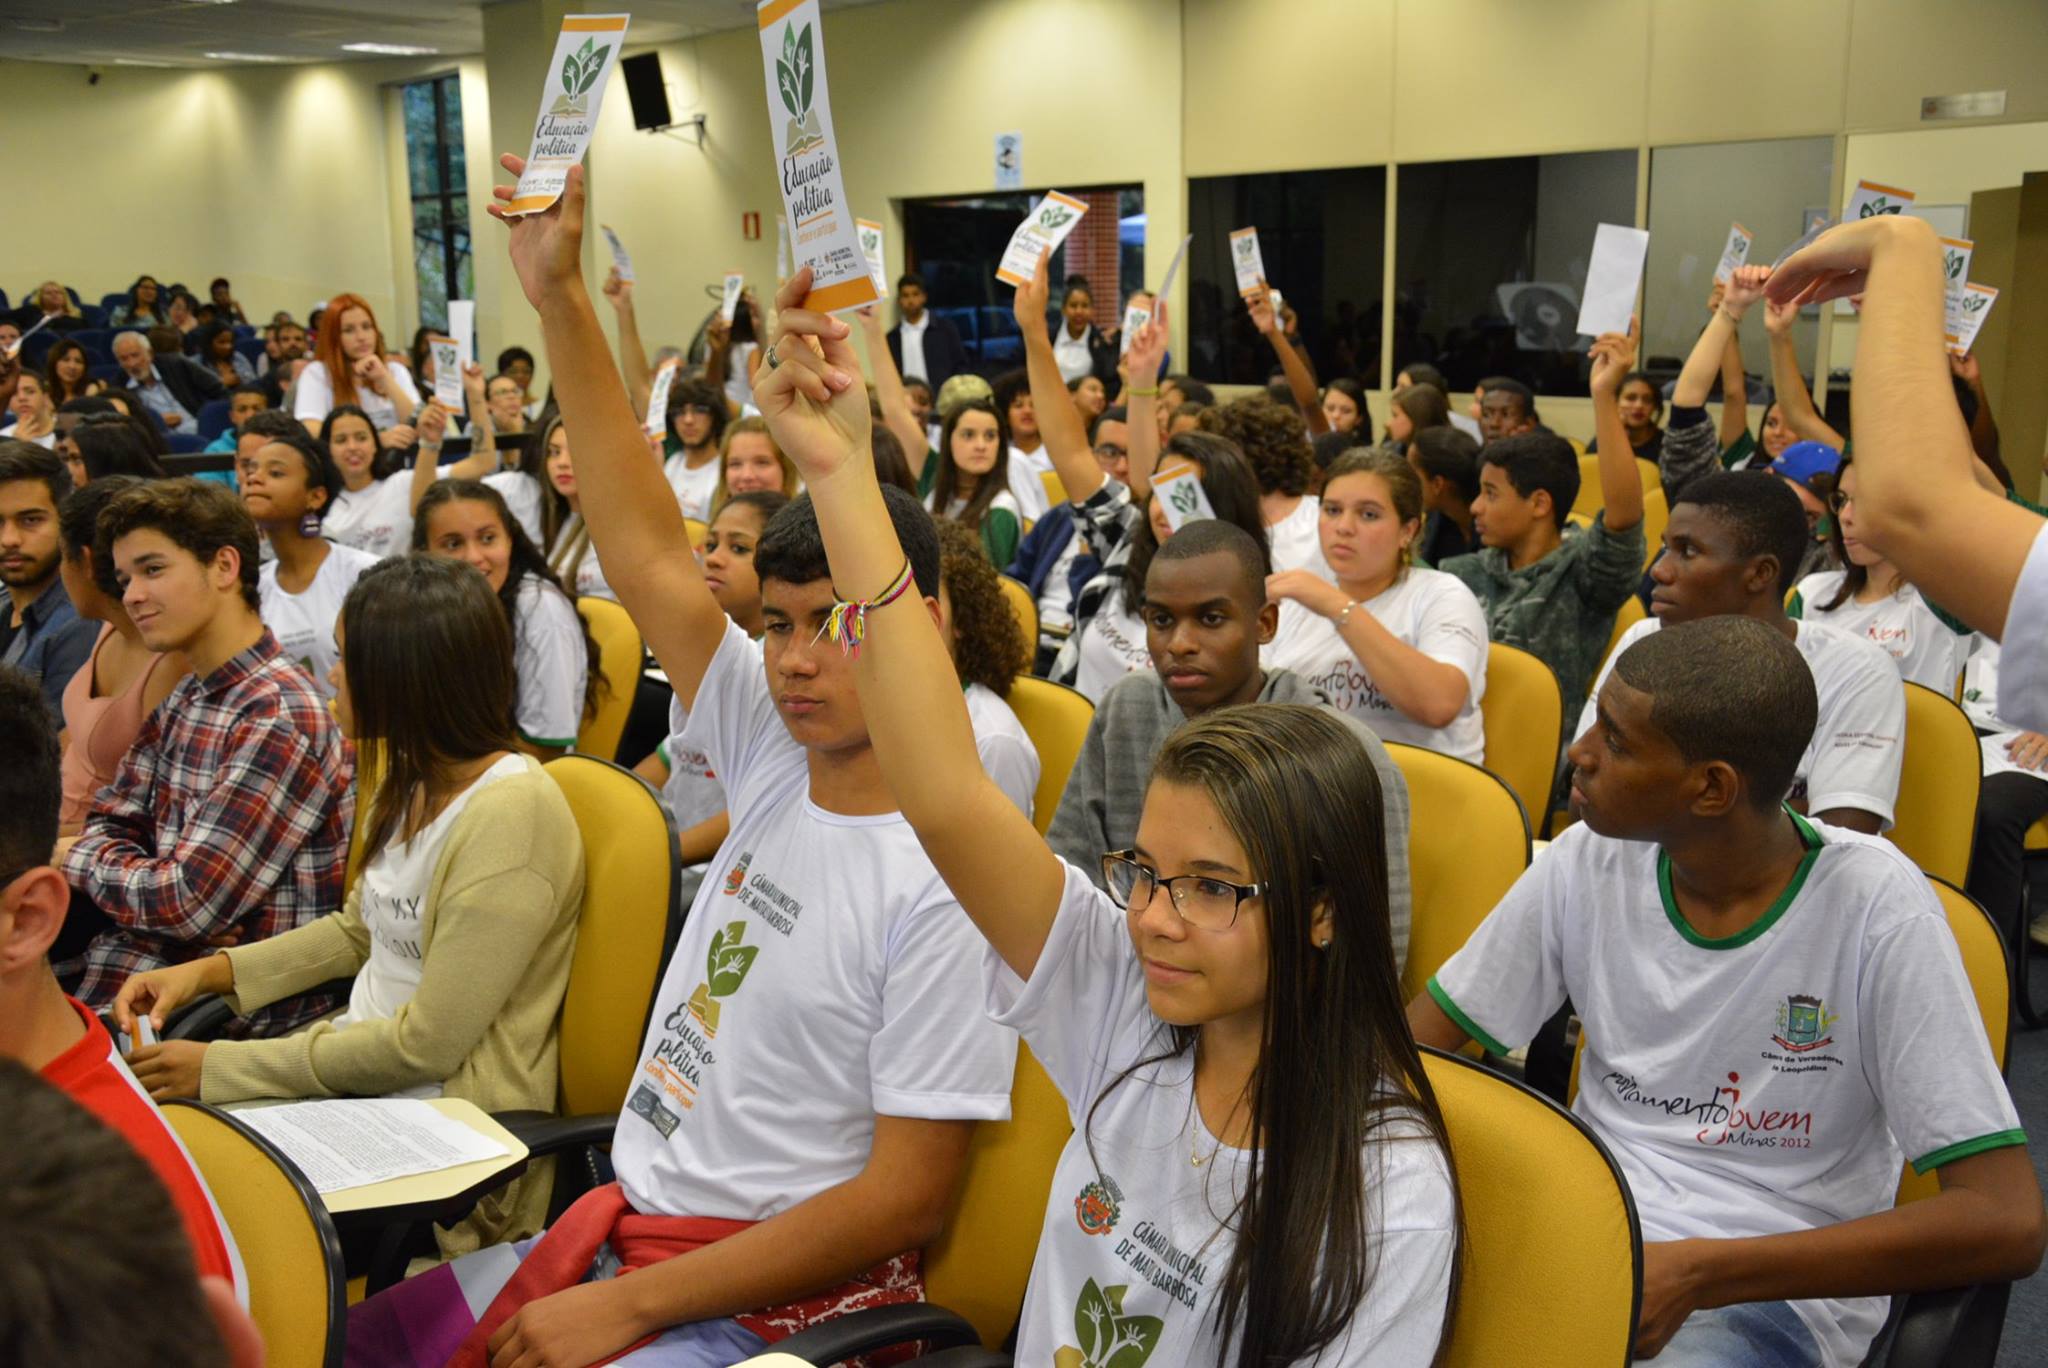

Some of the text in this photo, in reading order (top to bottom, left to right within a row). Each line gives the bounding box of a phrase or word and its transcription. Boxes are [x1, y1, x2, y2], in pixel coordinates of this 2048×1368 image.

[536, 114, 588, 139] Educação
[783, 152, 833, 195] Educação
[792, 185, 832, 229] política
[737, 886, 753, 904] DE
[1727, 1131, 1812, 1149] Minas 2012
[1114, 1237, 1137, 1262] DE
[1151, 1266, 1199, 1312] BARBOSA
